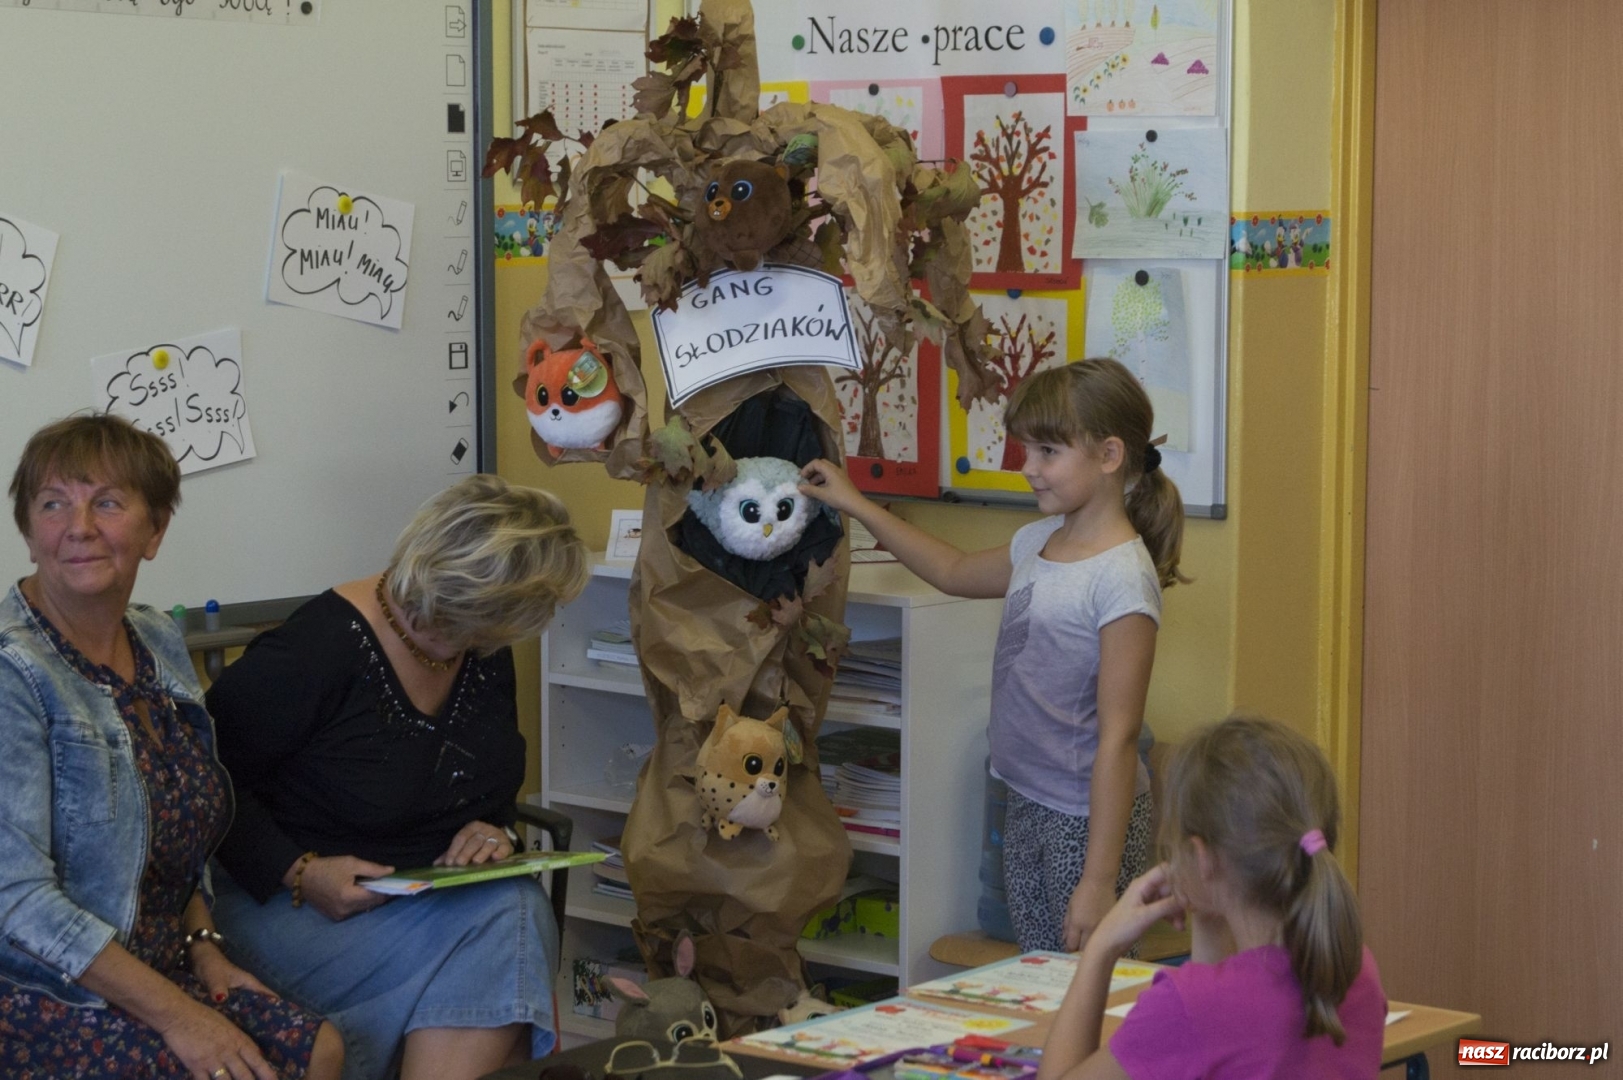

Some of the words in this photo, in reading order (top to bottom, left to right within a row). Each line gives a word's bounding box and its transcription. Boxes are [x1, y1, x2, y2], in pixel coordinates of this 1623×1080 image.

[807, 16, 909, 54] Nasze
[932, 24, 1025, 65] prace
[691, 276, 774, 309] GANG
[674, 304, 848, 368] SŁODZIAKÓW
